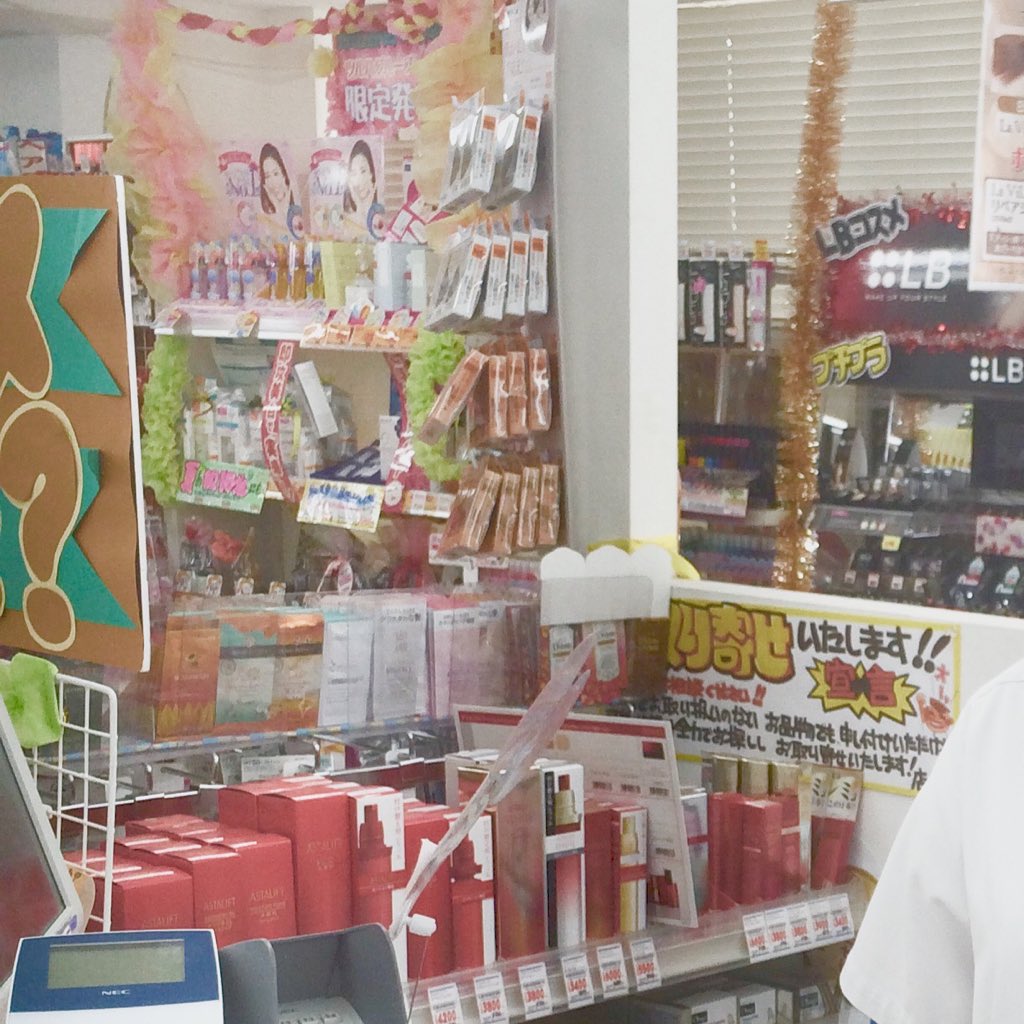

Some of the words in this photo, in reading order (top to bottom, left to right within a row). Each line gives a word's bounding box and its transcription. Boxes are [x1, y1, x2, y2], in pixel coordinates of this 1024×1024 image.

[815, 197, 907, 260] LBコスメ
[900, 250, 951, 290] LB
[991, 356, 1024, 383] LB
